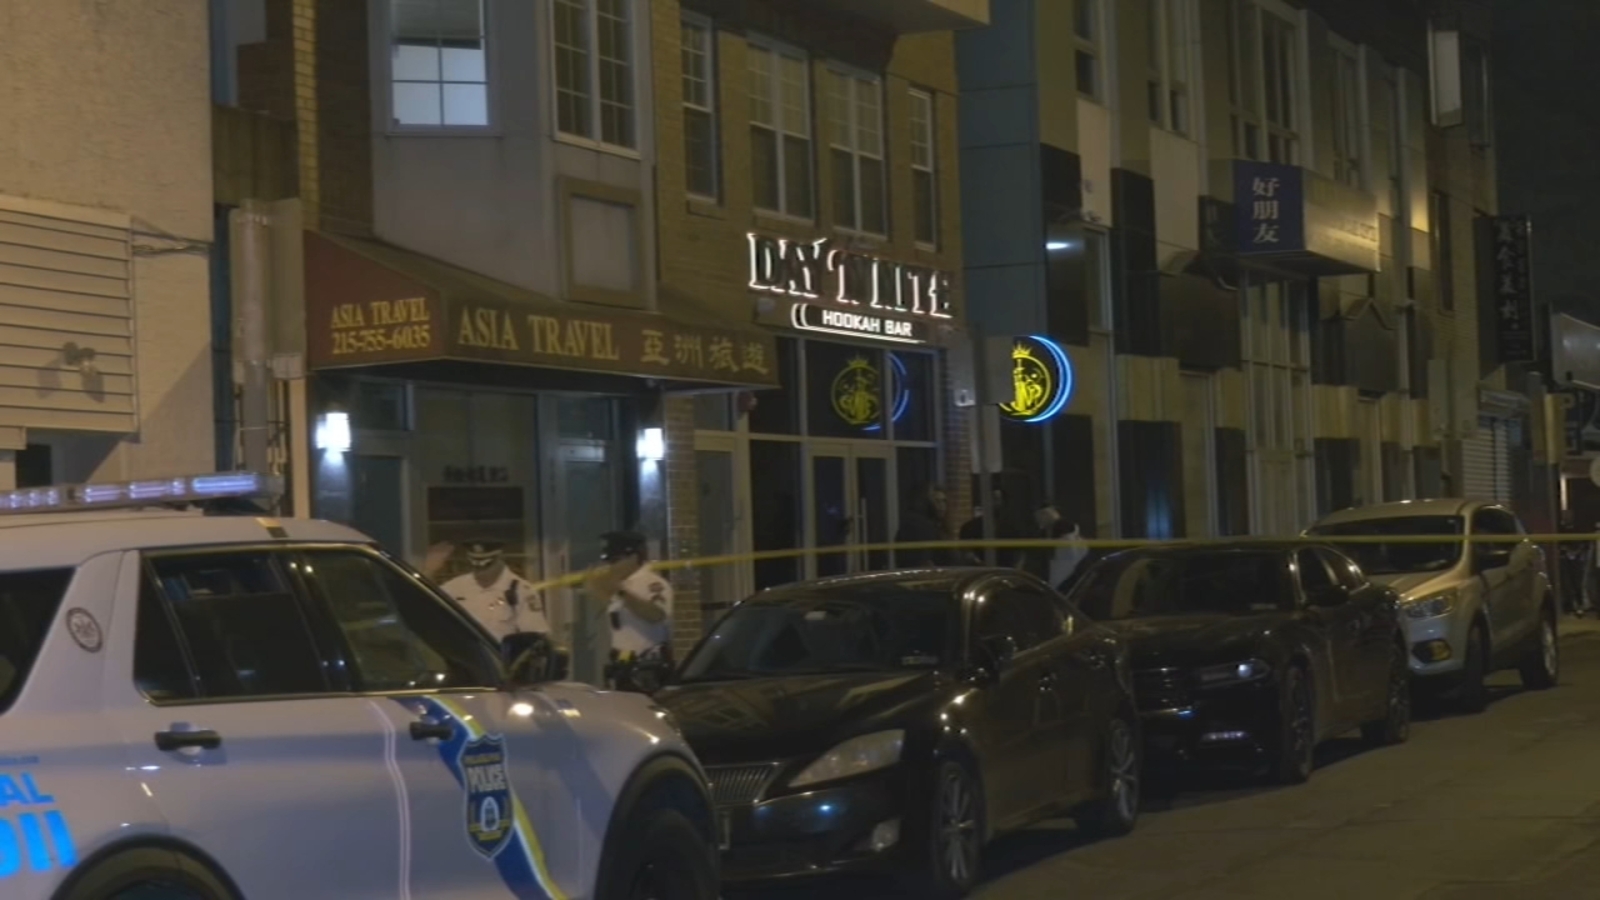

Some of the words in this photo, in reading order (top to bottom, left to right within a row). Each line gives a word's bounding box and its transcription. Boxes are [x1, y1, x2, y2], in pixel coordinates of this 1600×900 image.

[1252, 177, 1280, 244] 好朋友
[331, 303, 365, 328] ASIA
[370, 297, 430, 325] TRAVEL
[822, 309, 880, 333] HOOKAH
[884, 320, 912, 337] BAR
[331, 324, 430, 354] 215-755-6035
[458, 306, 519, 351] ASIA
[527, 315, 619, 361] TRAVEL
